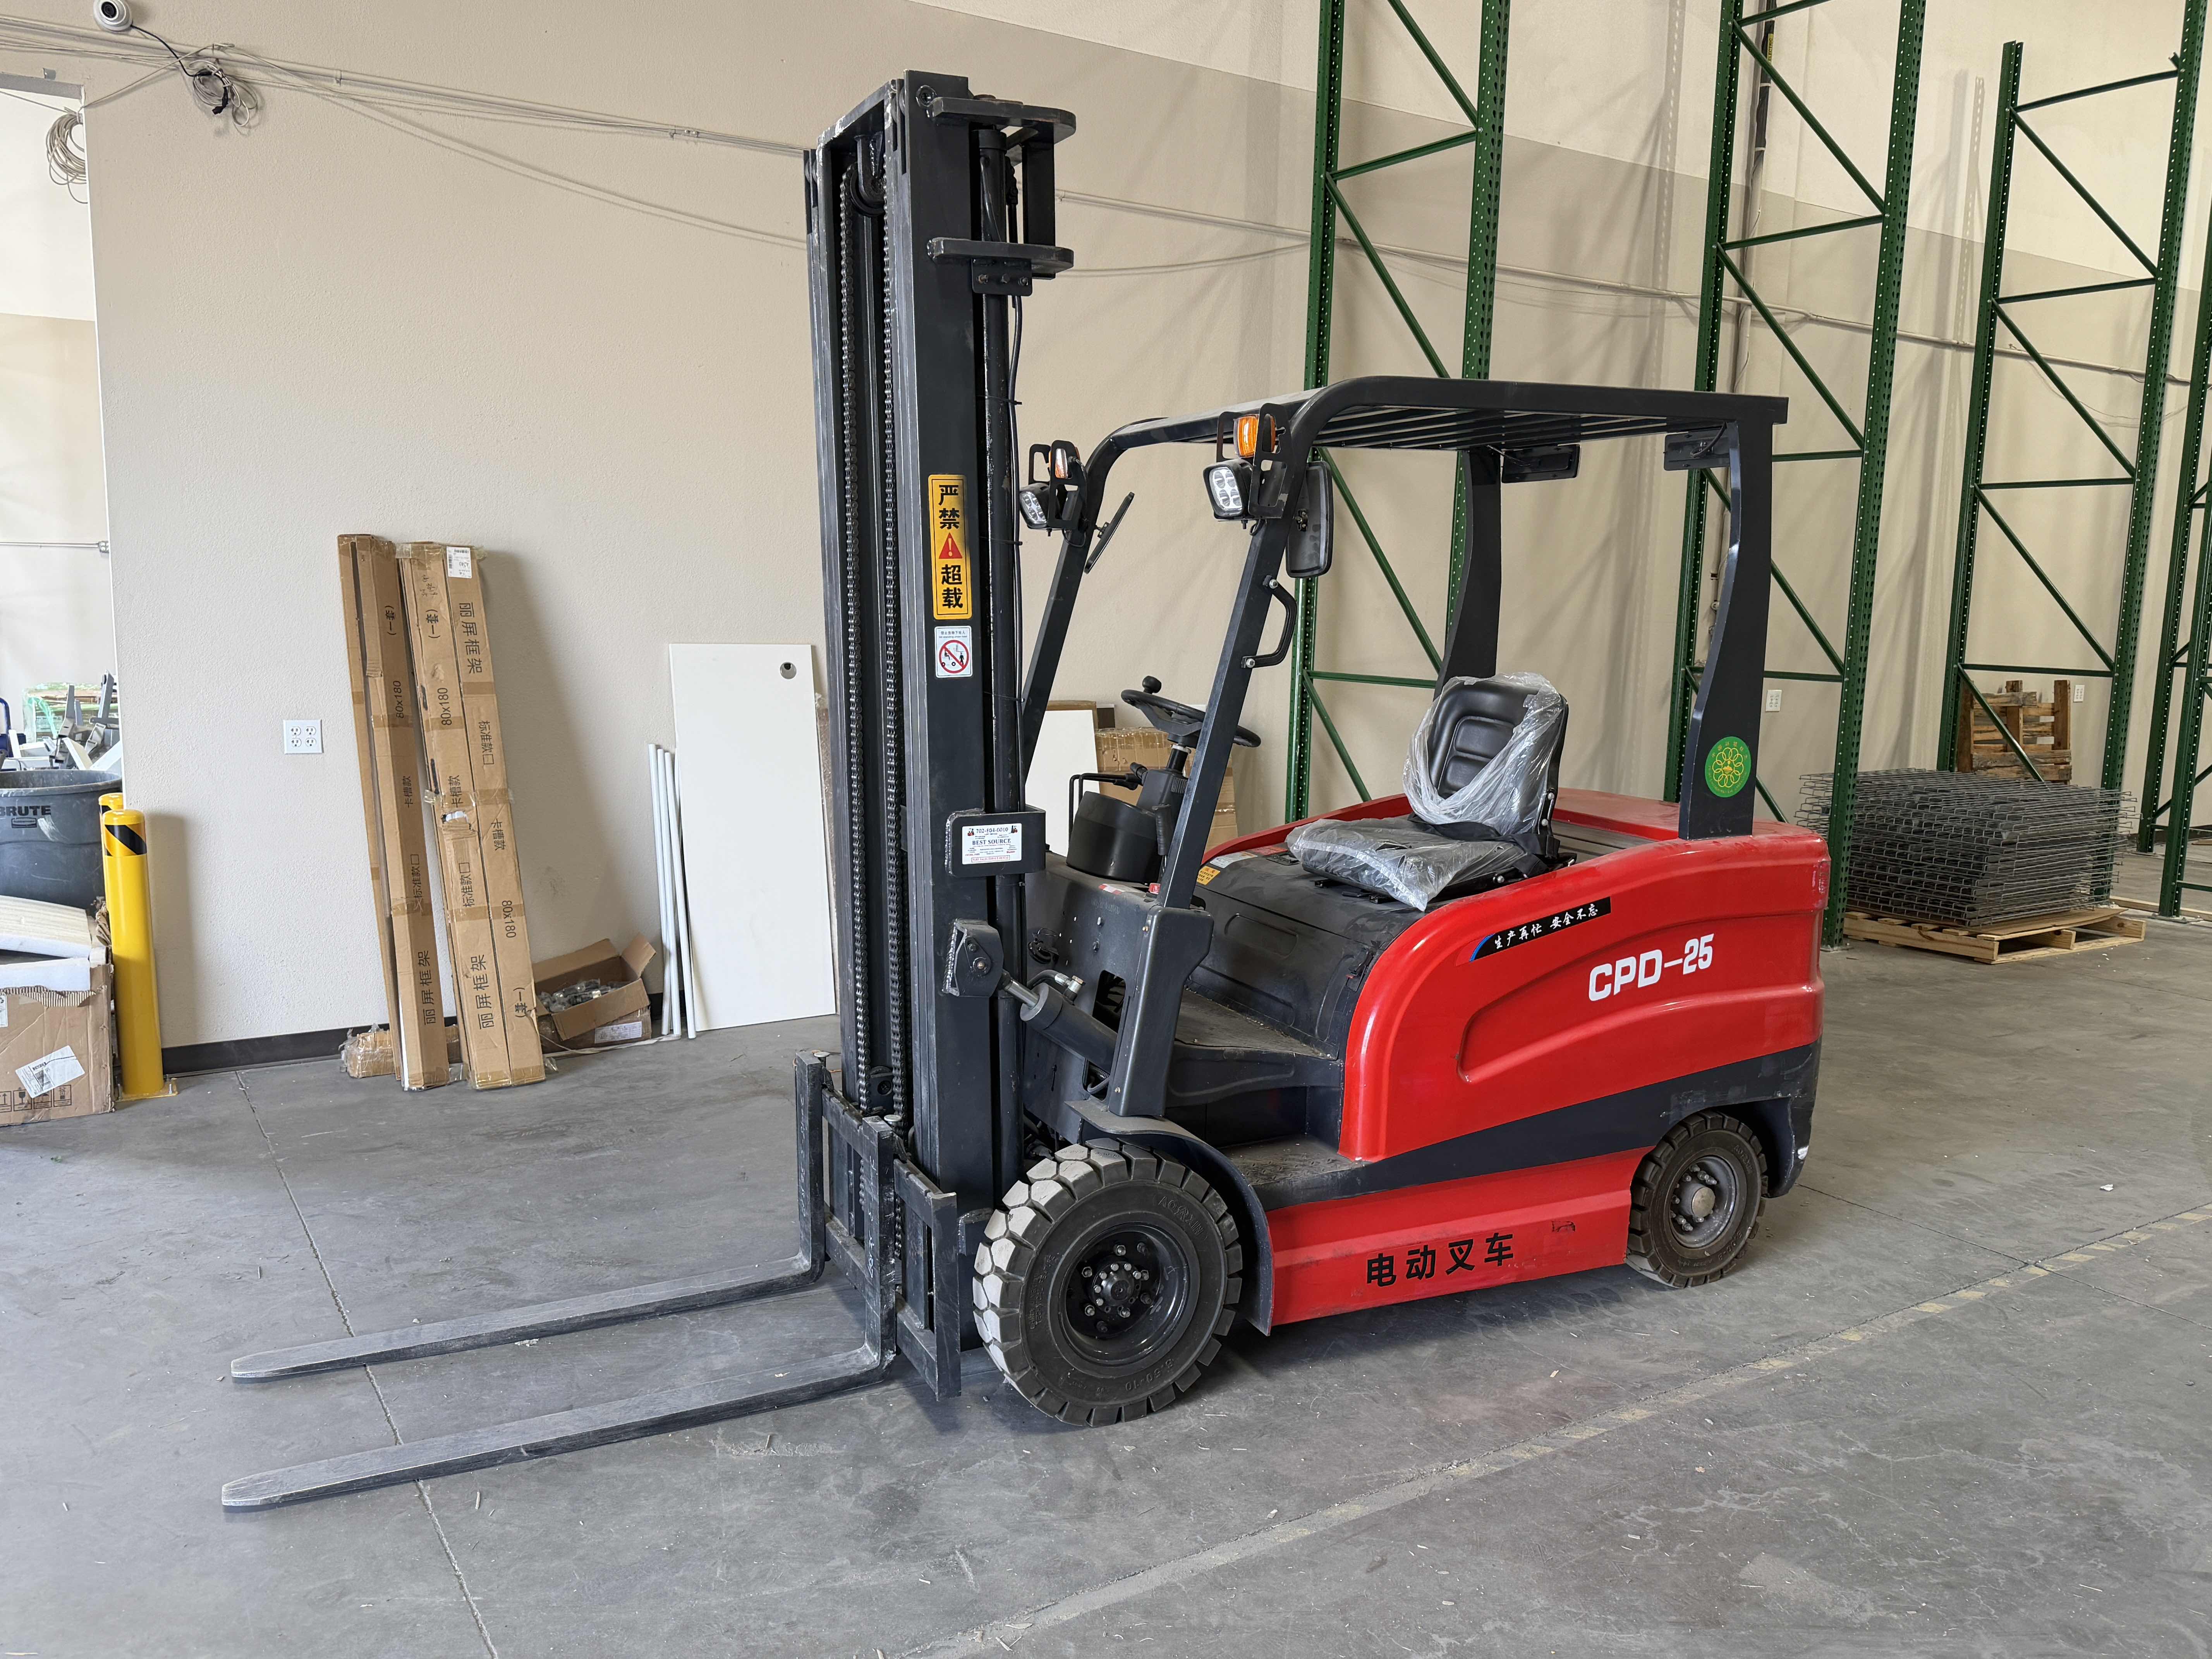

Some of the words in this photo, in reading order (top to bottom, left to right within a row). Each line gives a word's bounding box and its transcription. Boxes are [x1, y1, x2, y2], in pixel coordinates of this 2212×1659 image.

[393, 680, 404, 719] 80x180
[437, 687, 452, 726] 80x180
[502, 900, 517, 938] 80x180
[1589, 933, 1714, 1001] CPD-25
[1366, 1232, 1514, 1287] 电动叉车
